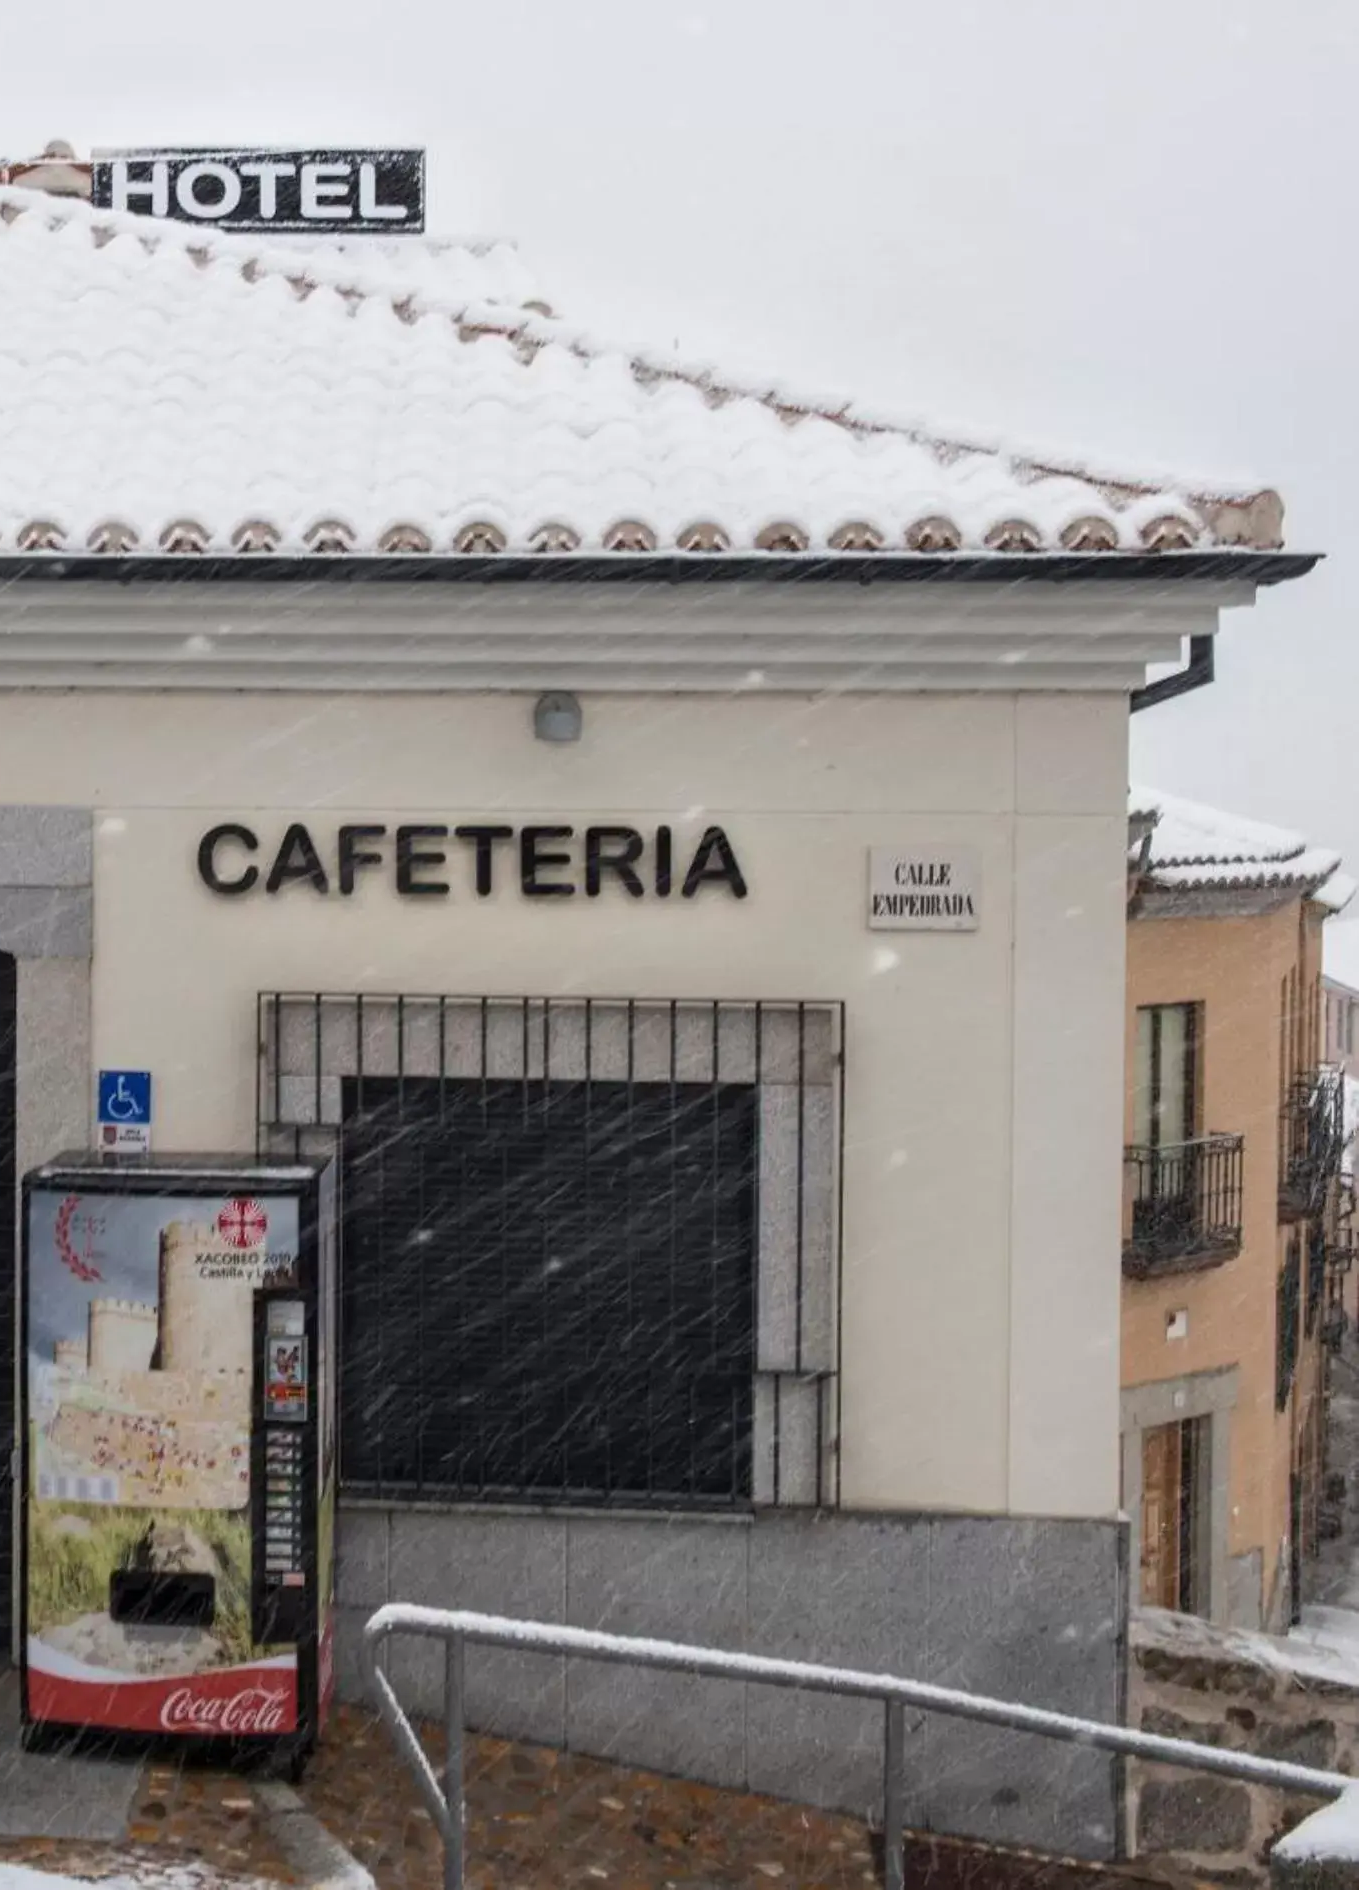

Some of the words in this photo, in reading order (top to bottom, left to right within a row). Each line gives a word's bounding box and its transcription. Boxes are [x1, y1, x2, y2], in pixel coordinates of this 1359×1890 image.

[111, 160, 408, 219] HOTEL
[196, 822, 749, 899] CAFETERIA
[894, 862, 952, 887] CALLE
[872, 893, 974, 917] EMPEDRADA
[194, 1252, 259, 1266] XACOBEO
[199, 1266, 244, 1279] Castilla
